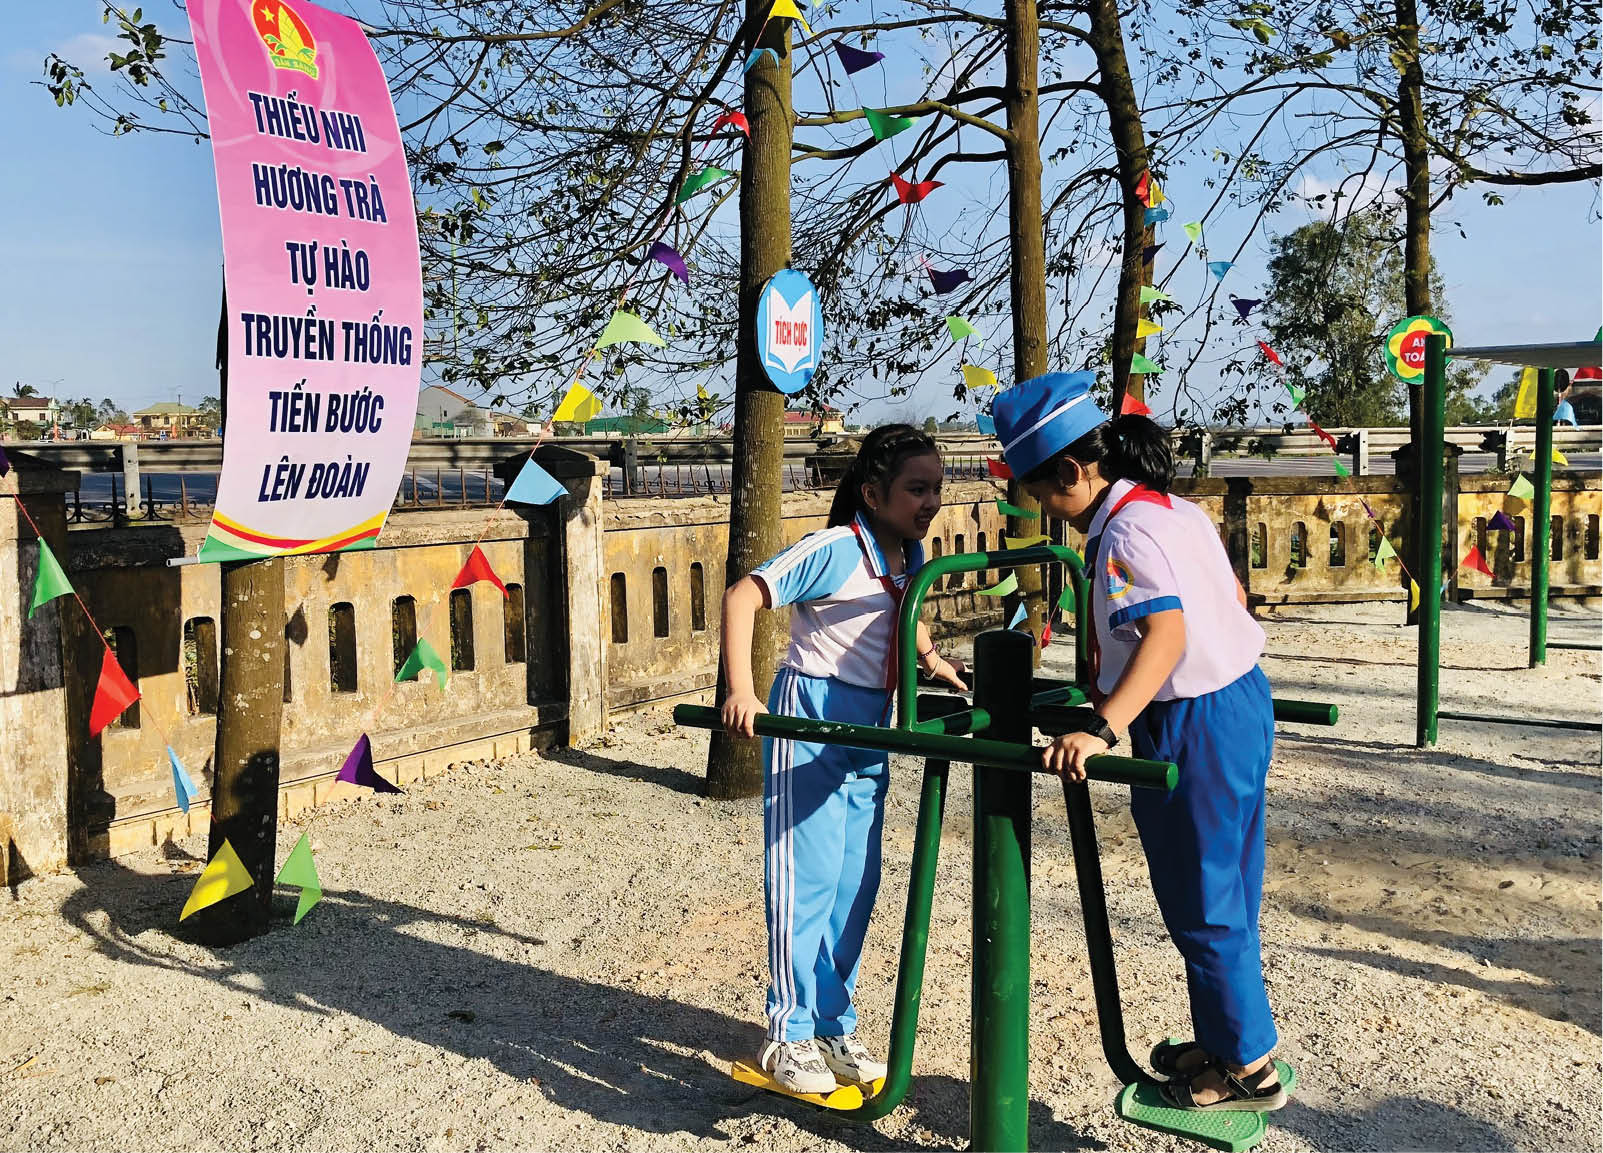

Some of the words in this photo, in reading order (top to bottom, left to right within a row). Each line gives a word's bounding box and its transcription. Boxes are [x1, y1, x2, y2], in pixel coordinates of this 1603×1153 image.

[248, 90, 320, 143] THIẾU
[319, 110, 367, 153] NHI
[252, 163, 339, 216] HƯƠNG
[339, 175, 387, 223] TRÀ
[285, 240, 318, 295] TỰ
[323, 239, 370, 292] HÀO
[241, 304, 335, 361] TRUYỀN
[341, 309, 412, 366] THỐNG
[269, 378, 321, 433] TIẾN
[324, 385, 385, 434] BƯỚC
[257, 455, 307, 503] LÊN
[304, 454, 371, 500] ĐOÀN
